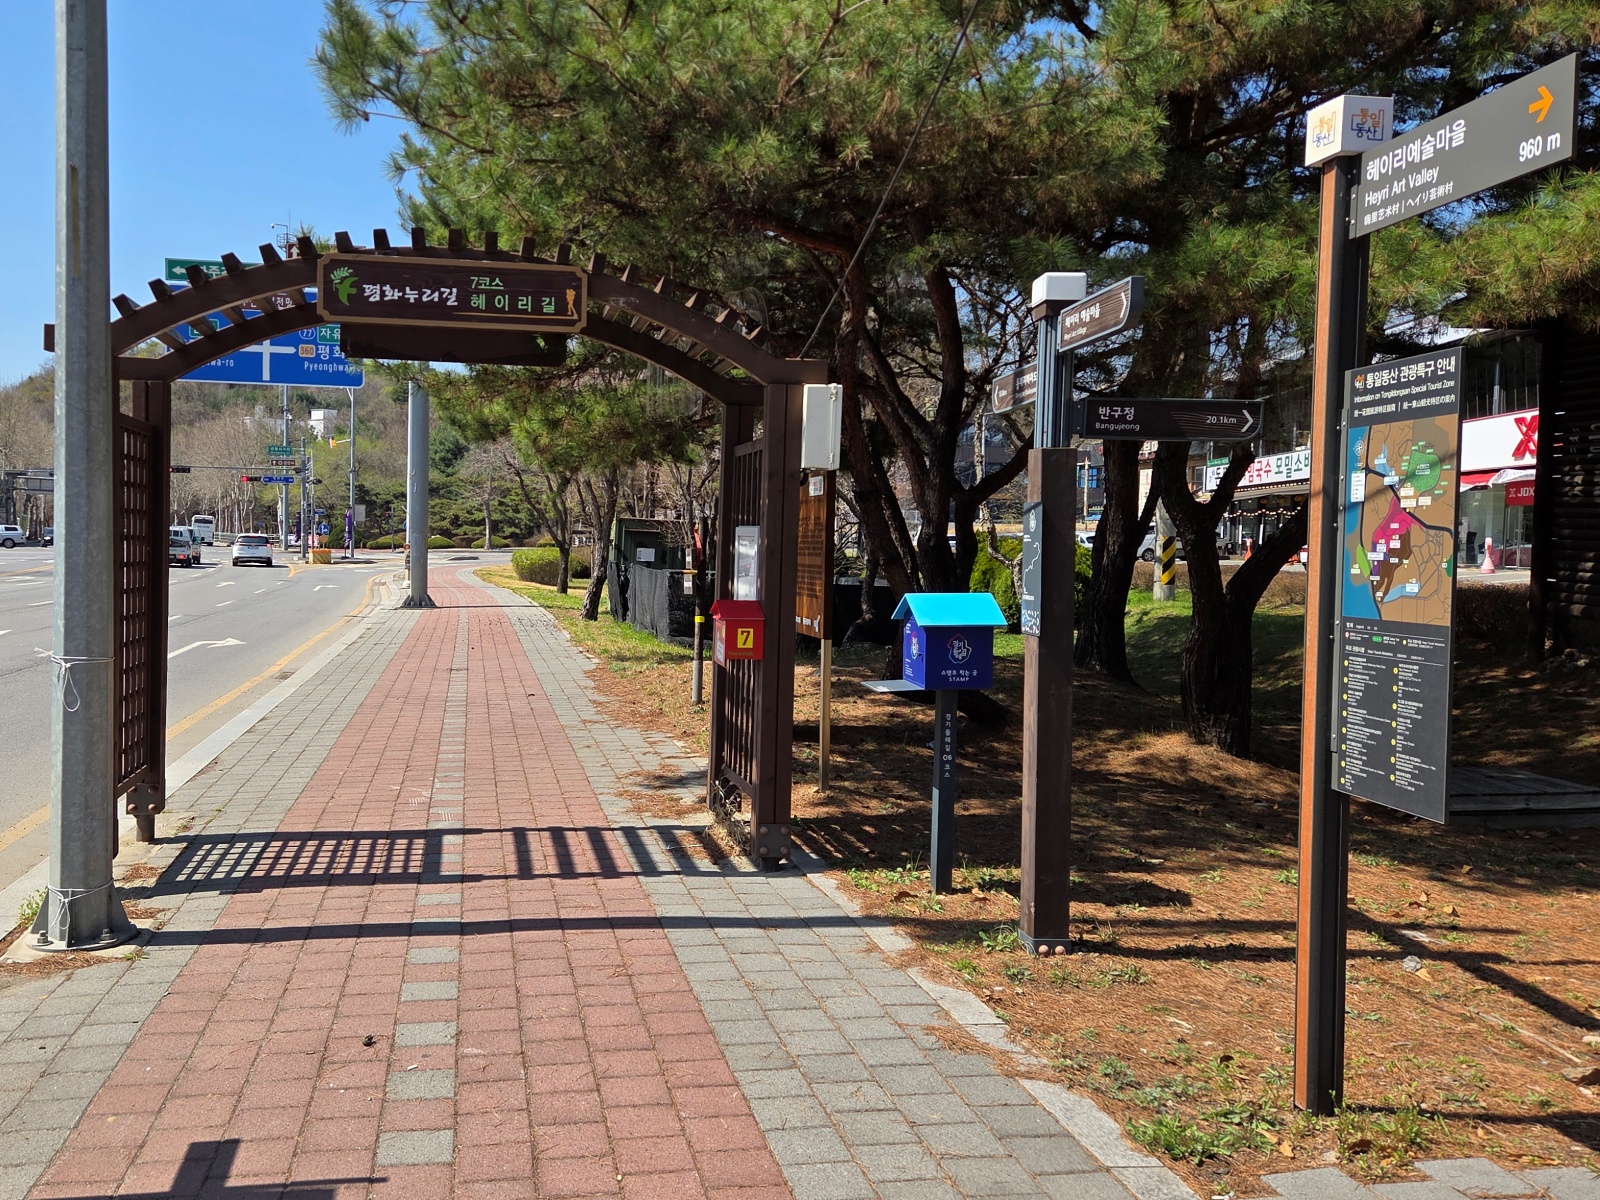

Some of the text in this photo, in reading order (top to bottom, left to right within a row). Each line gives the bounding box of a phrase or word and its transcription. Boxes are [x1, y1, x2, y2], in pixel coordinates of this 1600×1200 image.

[1366, 119, 1467, 182] 헤이리예술마을
[1518, 131, 1561, 163] 960 m
[1364, 165, 1440, 208] Heyri Art Valley
[362, 276, 504, 306] 평화누리길 7코스
[1065, 302, 1100, 328] 헤이리 예술마을
[302, 328, 313, 338] 77
[300, 346, 314, 356] 360
[1366, 367, 1399, 389] 통일동산
[1400, 360, 1435, 382] 관광특구
[1436, 356, 1456, 375] 안내
[1354, 393, 1375, 404] Information
[1374, 392, 1380, 400] on
[1410, 383, 1427, 394] Special
[1428, 381, 1442, 390] Tourist
[1442, 379, 1455, 388] Zone
[1098, 406, 1135, 421] 반구정
[1206, 415, 1237, 426] 20.1km
[1095, 422, 1140, 432] Bangujeong
[1517, 486, 1536, 498] JDX
[740, 630, 751, 646] 7
[944, 764, 951, 778] 코스
